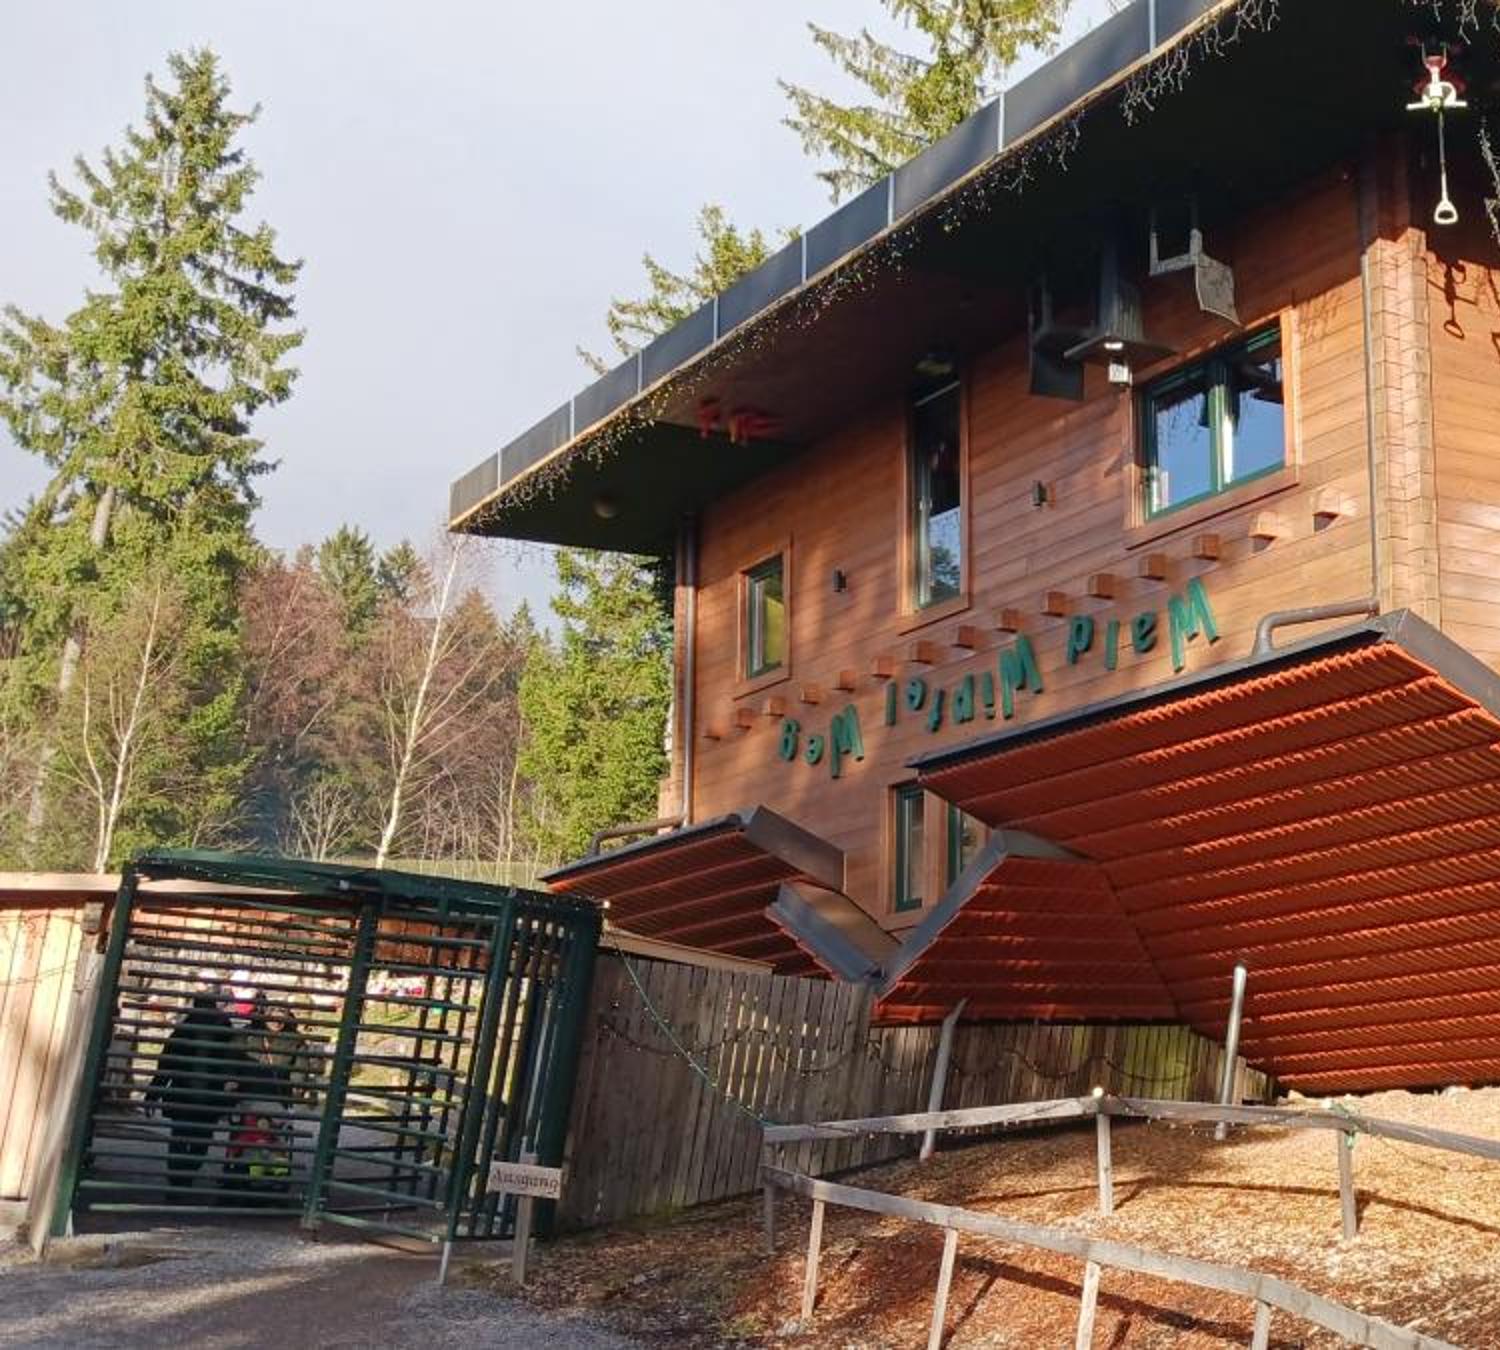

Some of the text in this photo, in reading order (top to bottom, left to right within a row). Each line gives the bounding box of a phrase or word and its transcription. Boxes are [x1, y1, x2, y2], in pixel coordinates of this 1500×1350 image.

[778, 576, 1219, 778] Wald Wipfel Weg
[492, 1168, 560, 1195] Ausgang
